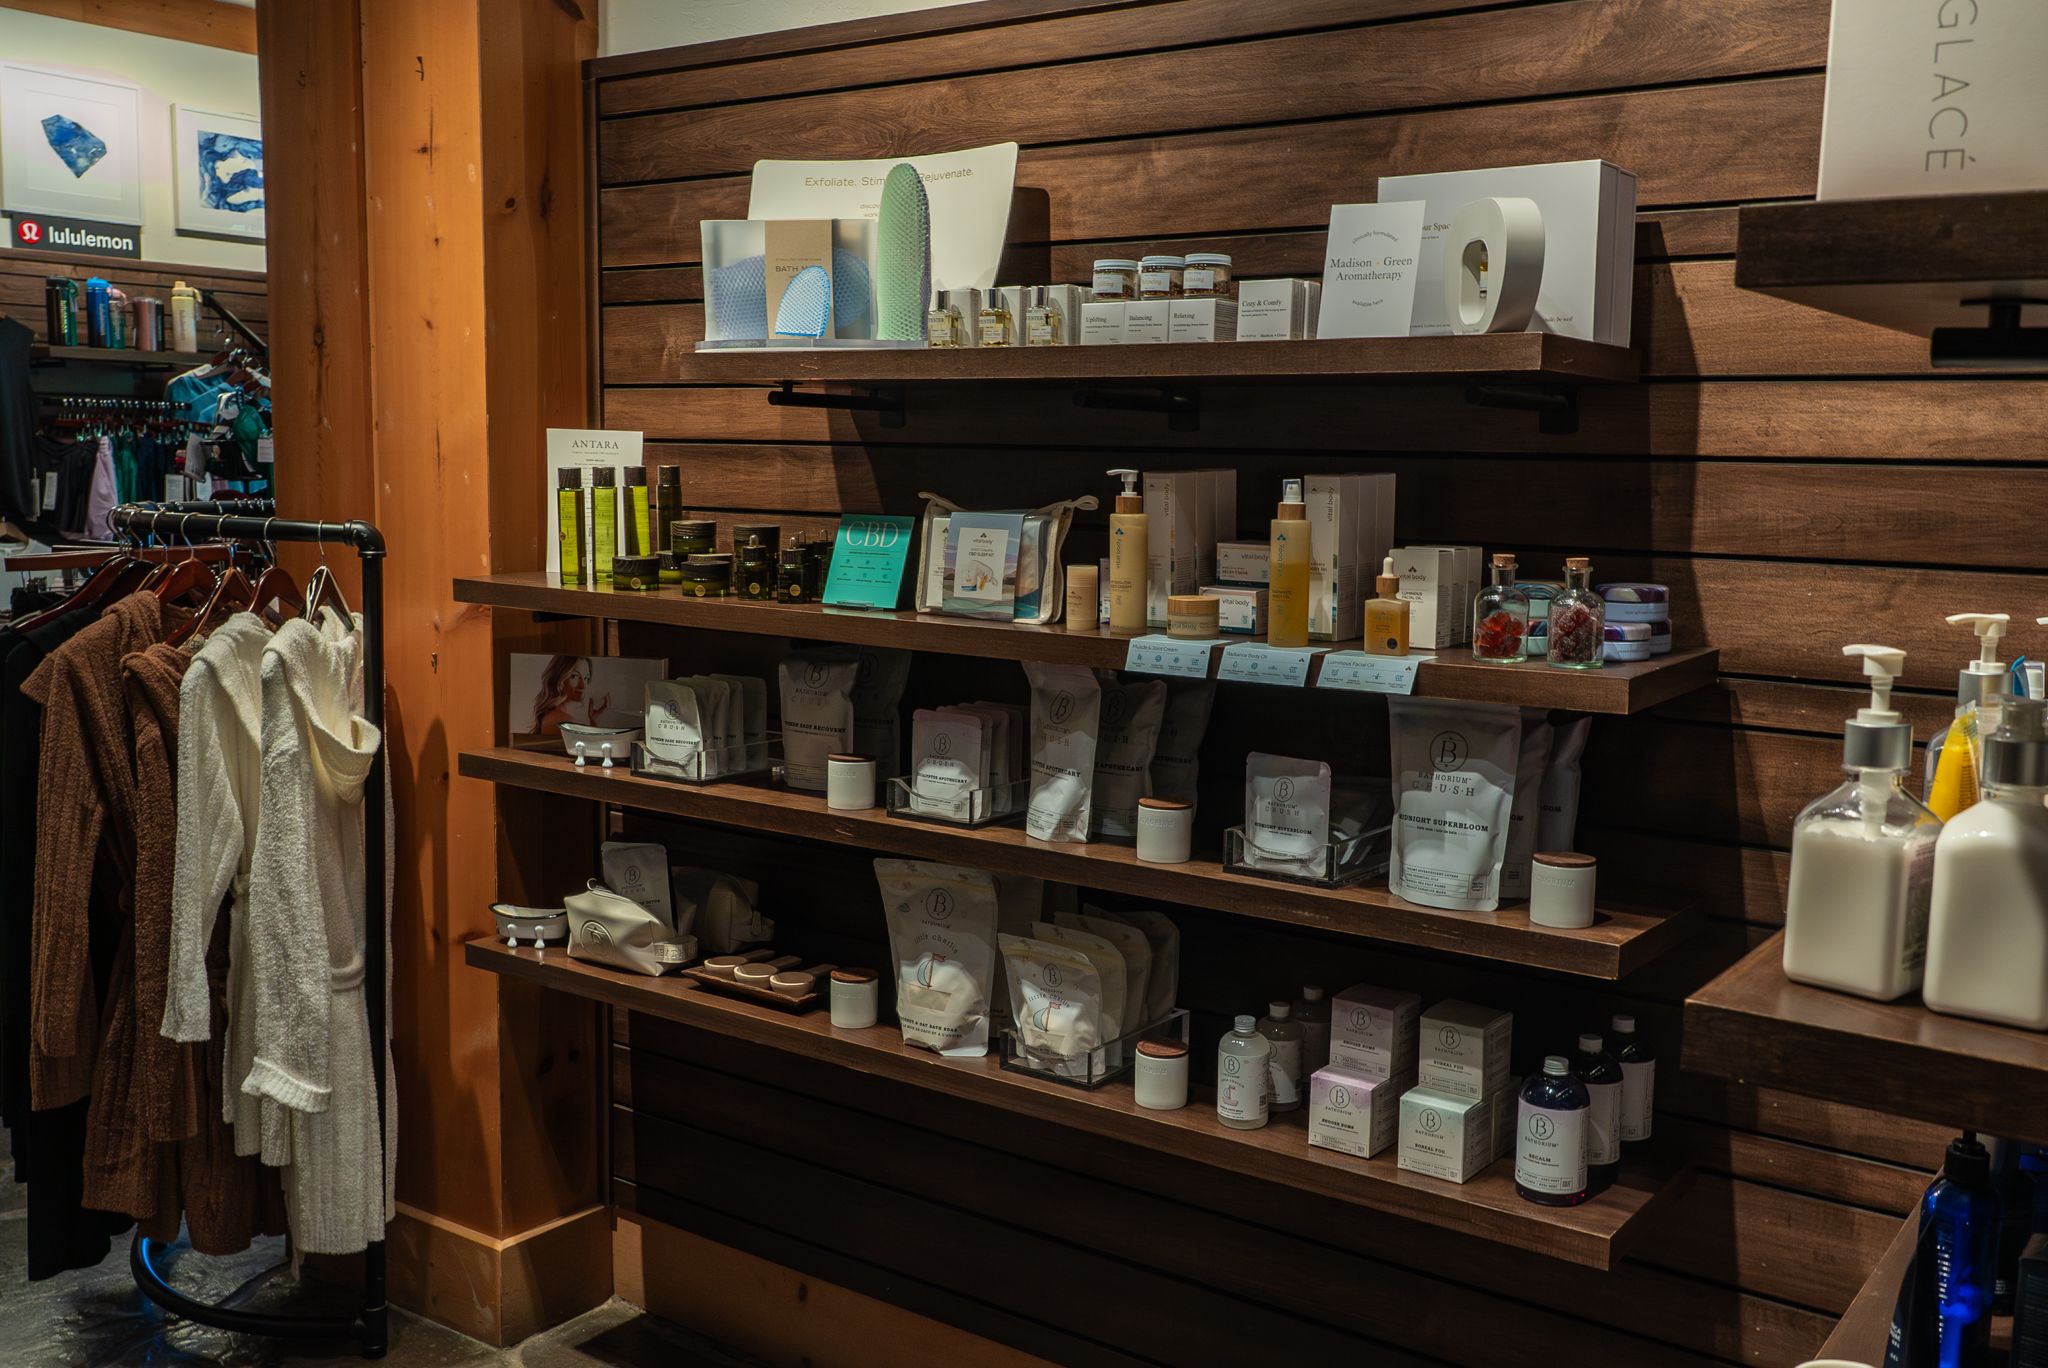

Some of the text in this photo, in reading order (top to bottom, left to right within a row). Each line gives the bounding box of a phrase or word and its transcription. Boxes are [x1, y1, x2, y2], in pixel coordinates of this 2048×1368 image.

[1924, 0, 1978, 172] GLACÉ
[804, 177, 857, 187] Exfoliate.
[861, 176, 886, 186] Stim
[1433, 222, 1450, 231] Spac
[48, 226, 134, 251] lululemon
[1330, 258, 1372, 268] Madison
[1384, 256, 1413, 267] Green
[1336, 270, 1404, 282] Aromatherapy
[572, 440, 620, 450] ANTARA
[846, 521, 899, 548] CBD
[1046, 764, 1081, 778] APOTHECARY
[1433, 819, 1489, 832] SUPERBLOOM
[1415, 1144, 1434, 1152] BOREAL
[1529, 1153, 1551, 1162] BECALM
